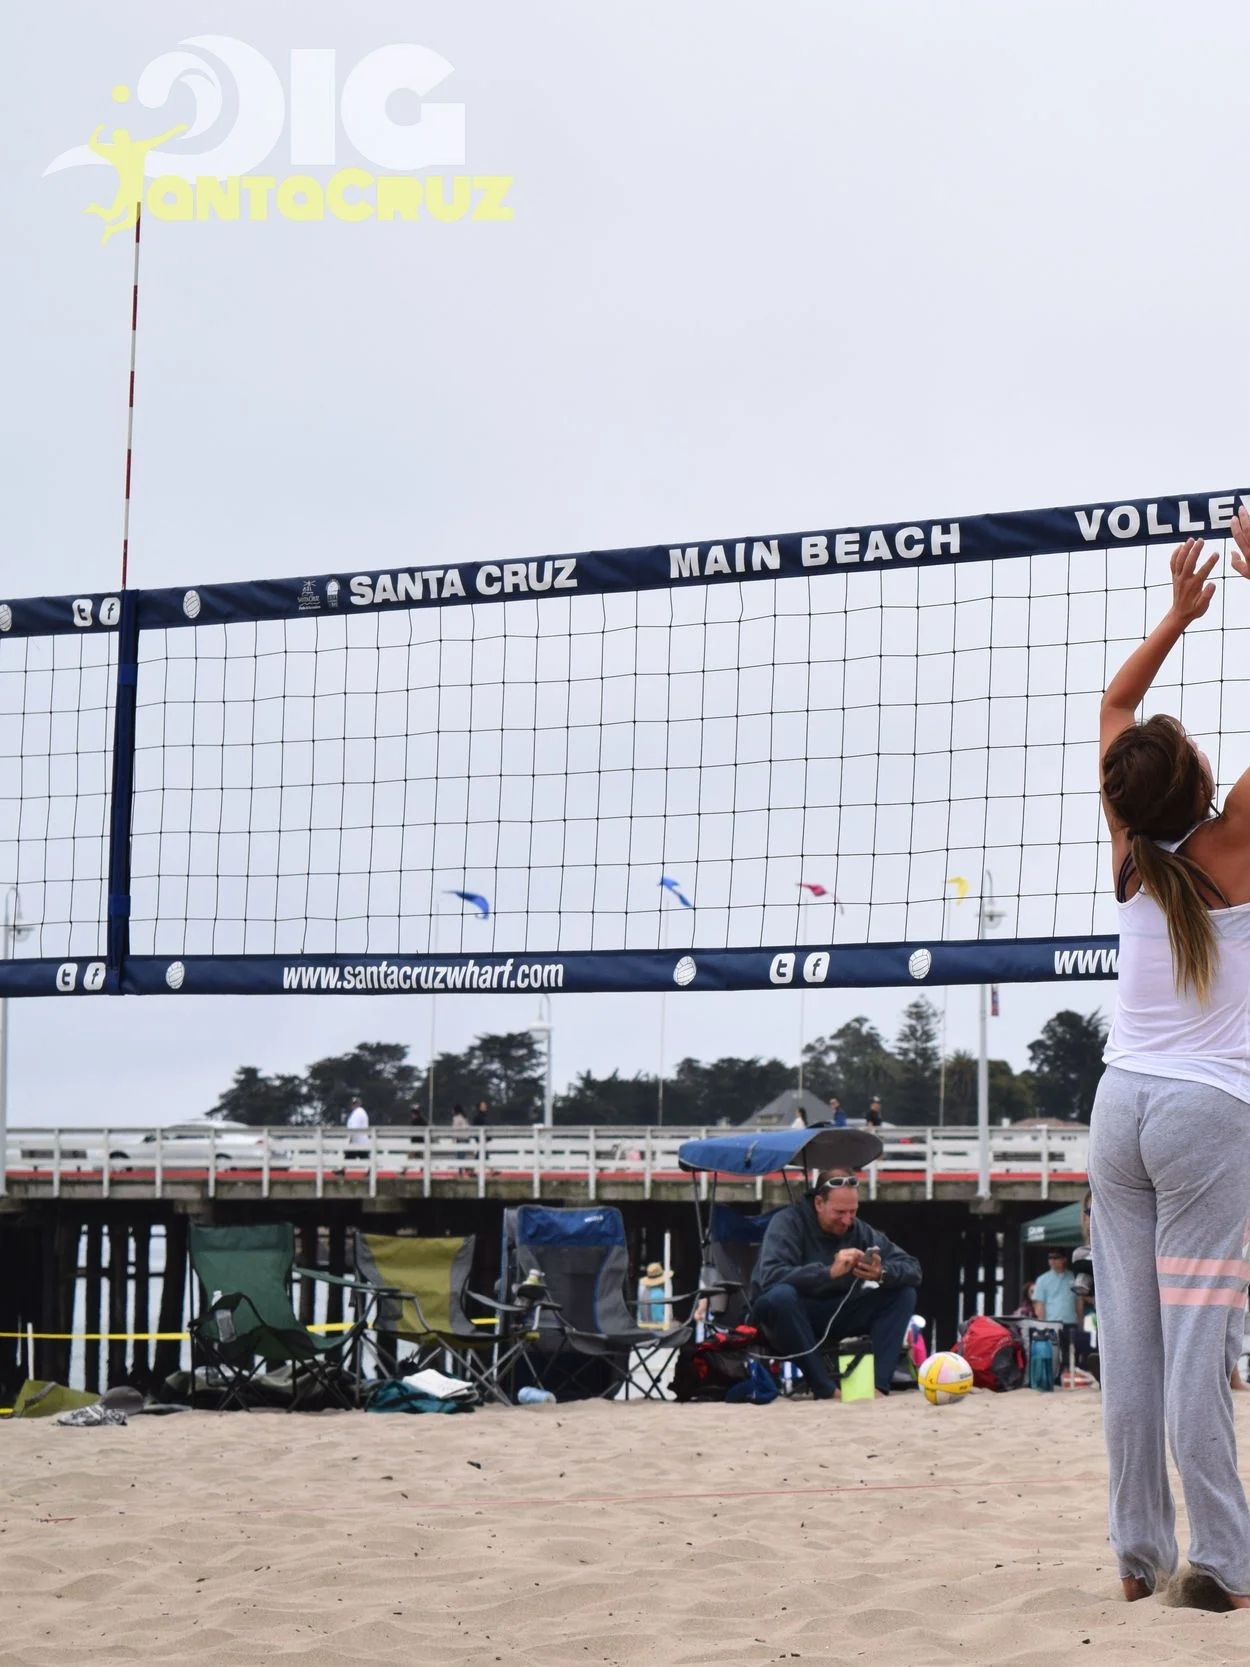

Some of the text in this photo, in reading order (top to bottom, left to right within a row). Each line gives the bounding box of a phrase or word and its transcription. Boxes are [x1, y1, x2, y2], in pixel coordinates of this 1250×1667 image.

[668, 522, 961, 579] MAIN BEACH
[349, 558, 578, 606] SANTA CRUZ
[282, 958, 564, 990] www.santacruzwharf.com
